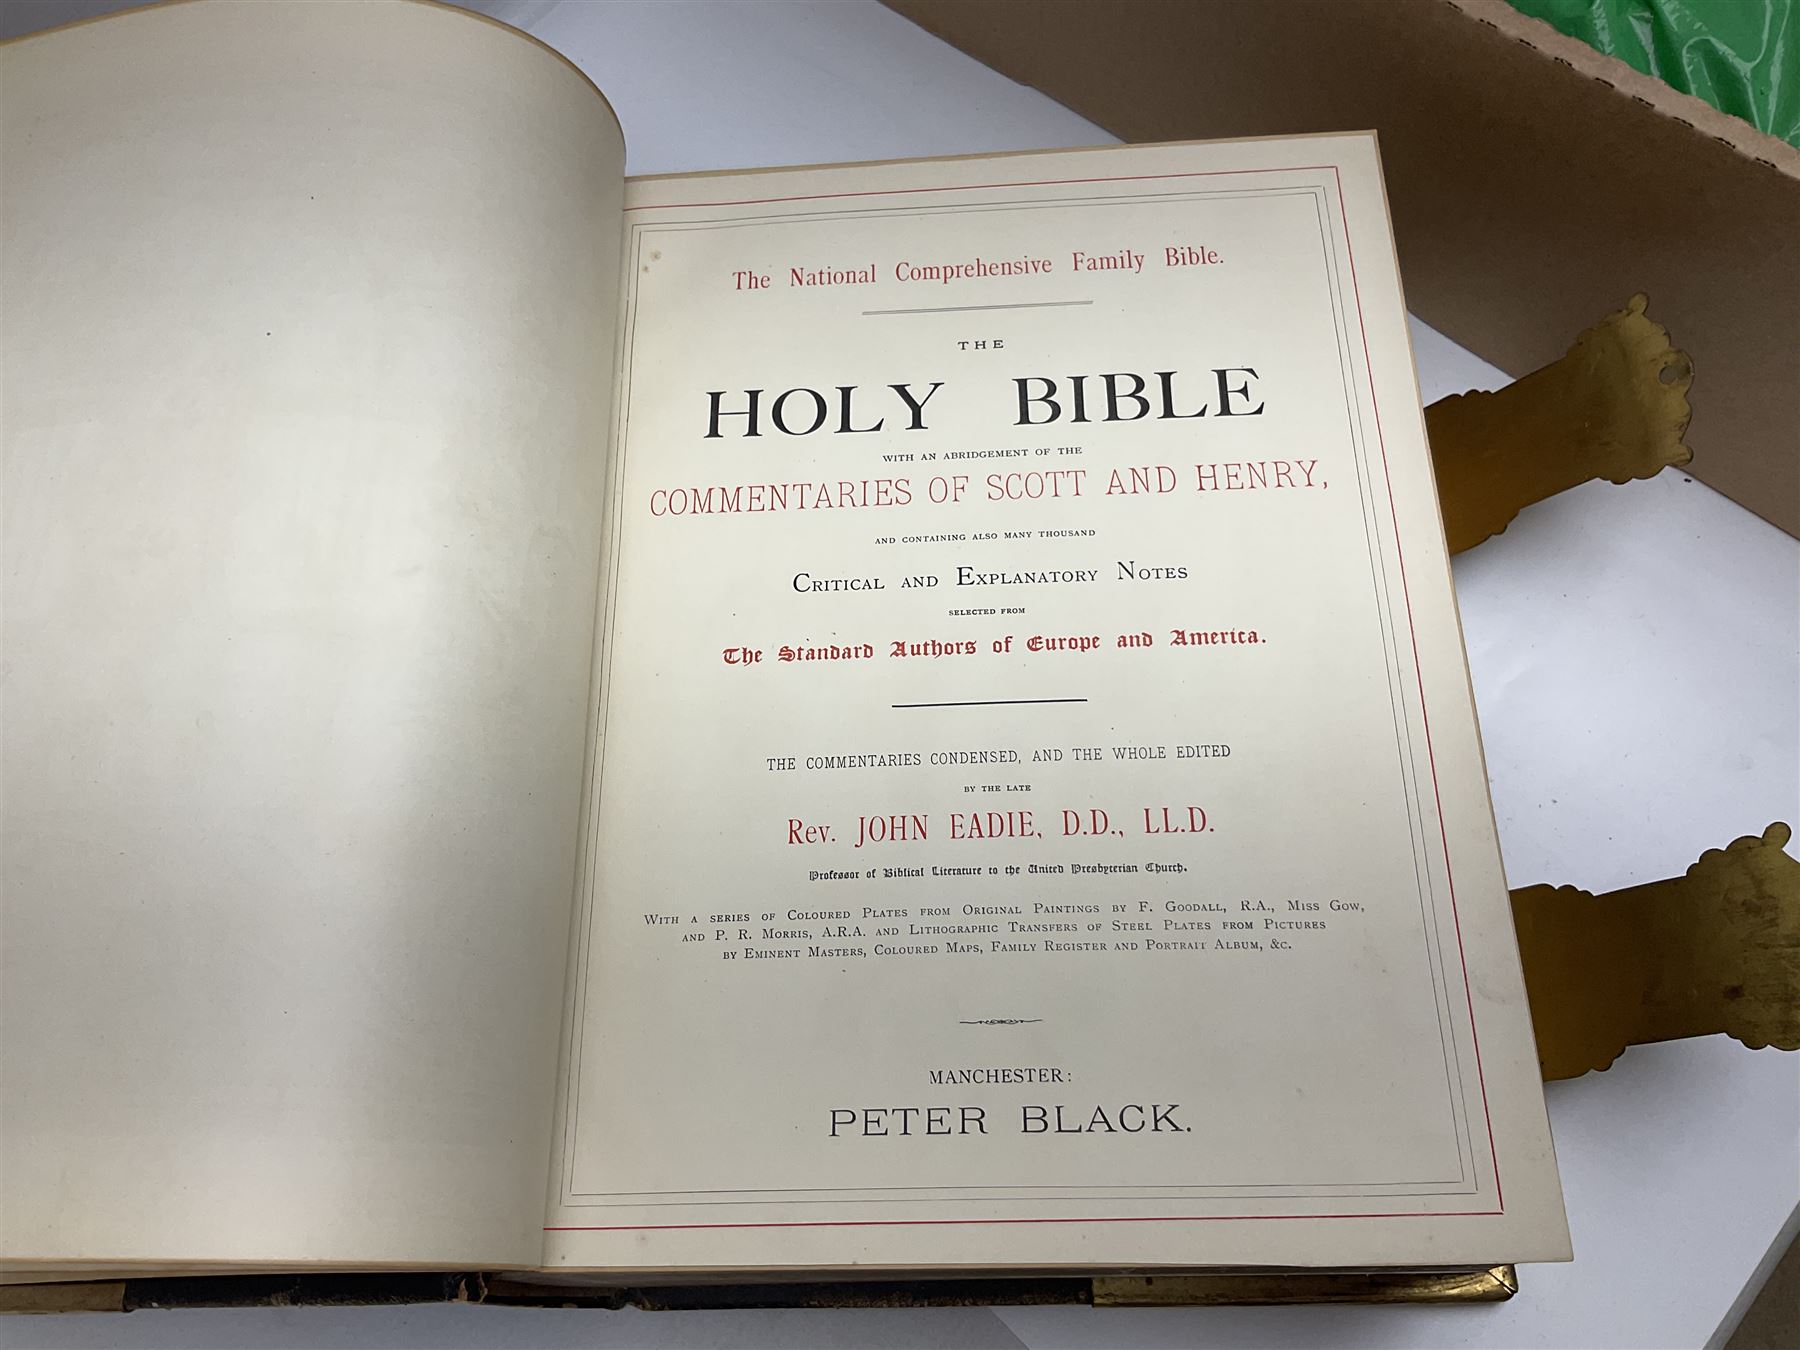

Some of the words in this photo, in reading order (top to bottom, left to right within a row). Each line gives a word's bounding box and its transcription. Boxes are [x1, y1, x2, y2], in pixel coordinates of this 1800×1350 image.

[732, 271, 770, 290] The
[790, 264, 876, 287] National
[896, 256, 1052, 284] Comprehensive
[1072, 250, 1144, 274] Family
[1165, 246, 1223, 266] Bible.
[956, 339, 1005, 351] THE
[703, 382, 945, 438] HOLY
[1011, 368, 1264, 425] BIBLE
[881, 453, 915, 463] WITH
[920, 452, 937, 461] AN
[942, 448, 1029, 461] ABRIDGEMENT
[1034, 447, 1051, 457] OF
[1056, 446, 1083, 456] THE
[651, 479, 912, 516] COMMENTARIES
[929, 476, 968, 503] OF
[987, 470, 1086, 500] SCOTT
[1105, 466, 1176, 495] AND
[1195, 460, 1327, 491] HENRY,
[874, 536, 897, 545] AND
[901, 533, 967, 544] CONTAINING
[971, 532, 998, 541] ALSO
[1003, 530, 1033, 540] MANY
[1037, 529, 1096, 538] THOUSAND
[948, 608, 997, 617] SELECTED
[1000, 607, 1026, 615] FROM
[722, 647, 763, 667] The
[778, 643, 873, 662] Standard
[890, 640, 977, 659] Authors
[993, 636, 1013, 653] of
[1027, 636, 1100, 653] Europe
[1117, 632, 1153, 648] and
[1170, 628, 1266, 646] America.
[766, 757, 796, 772] THE
[806, 753, 921, 769] COMMENTARIES
[931, 750, 1021, 765] CONDENSED,
[1031, 748, 1063, 763] AND
[1071, 747, 1103, 761] THE
[1111, 746, 1167, 760] WHOLE
[1176, 744, 1231, 759] EDITED
[963, 785, 976, 793] BY
[980, 784, 1002, 793] THE
[1006, 784, 1032, 792] LATE
[788, 819, 835, 844] Rev.
[855, 815, 928, 848] JOHN
[950, 811, 1041, 839] EADIE,
[1062, 809, 1123, 838] D.D.,
[1144, 807, 1214, 833] LL.D.
[808, 869, 860, 882] Professor
[865, 868, 877, 879] of
[882, 866, 925, 879] Biblical
[931, 865, 982, 877] Literature
[988, 866, 999, 876] to
[1004, 864, 1021, 877] the
[1027, 863, 1065, 874] United
[1070, 862, 1139, 875] Presbyterian
[1144, 862, 1188, 875] Church.
[929, 1068, 1071, 1084] MANCHESTER:
[828, 1107, 988, 1137] PETER
[1021, 1104, 1191, 1133] BLACK.
